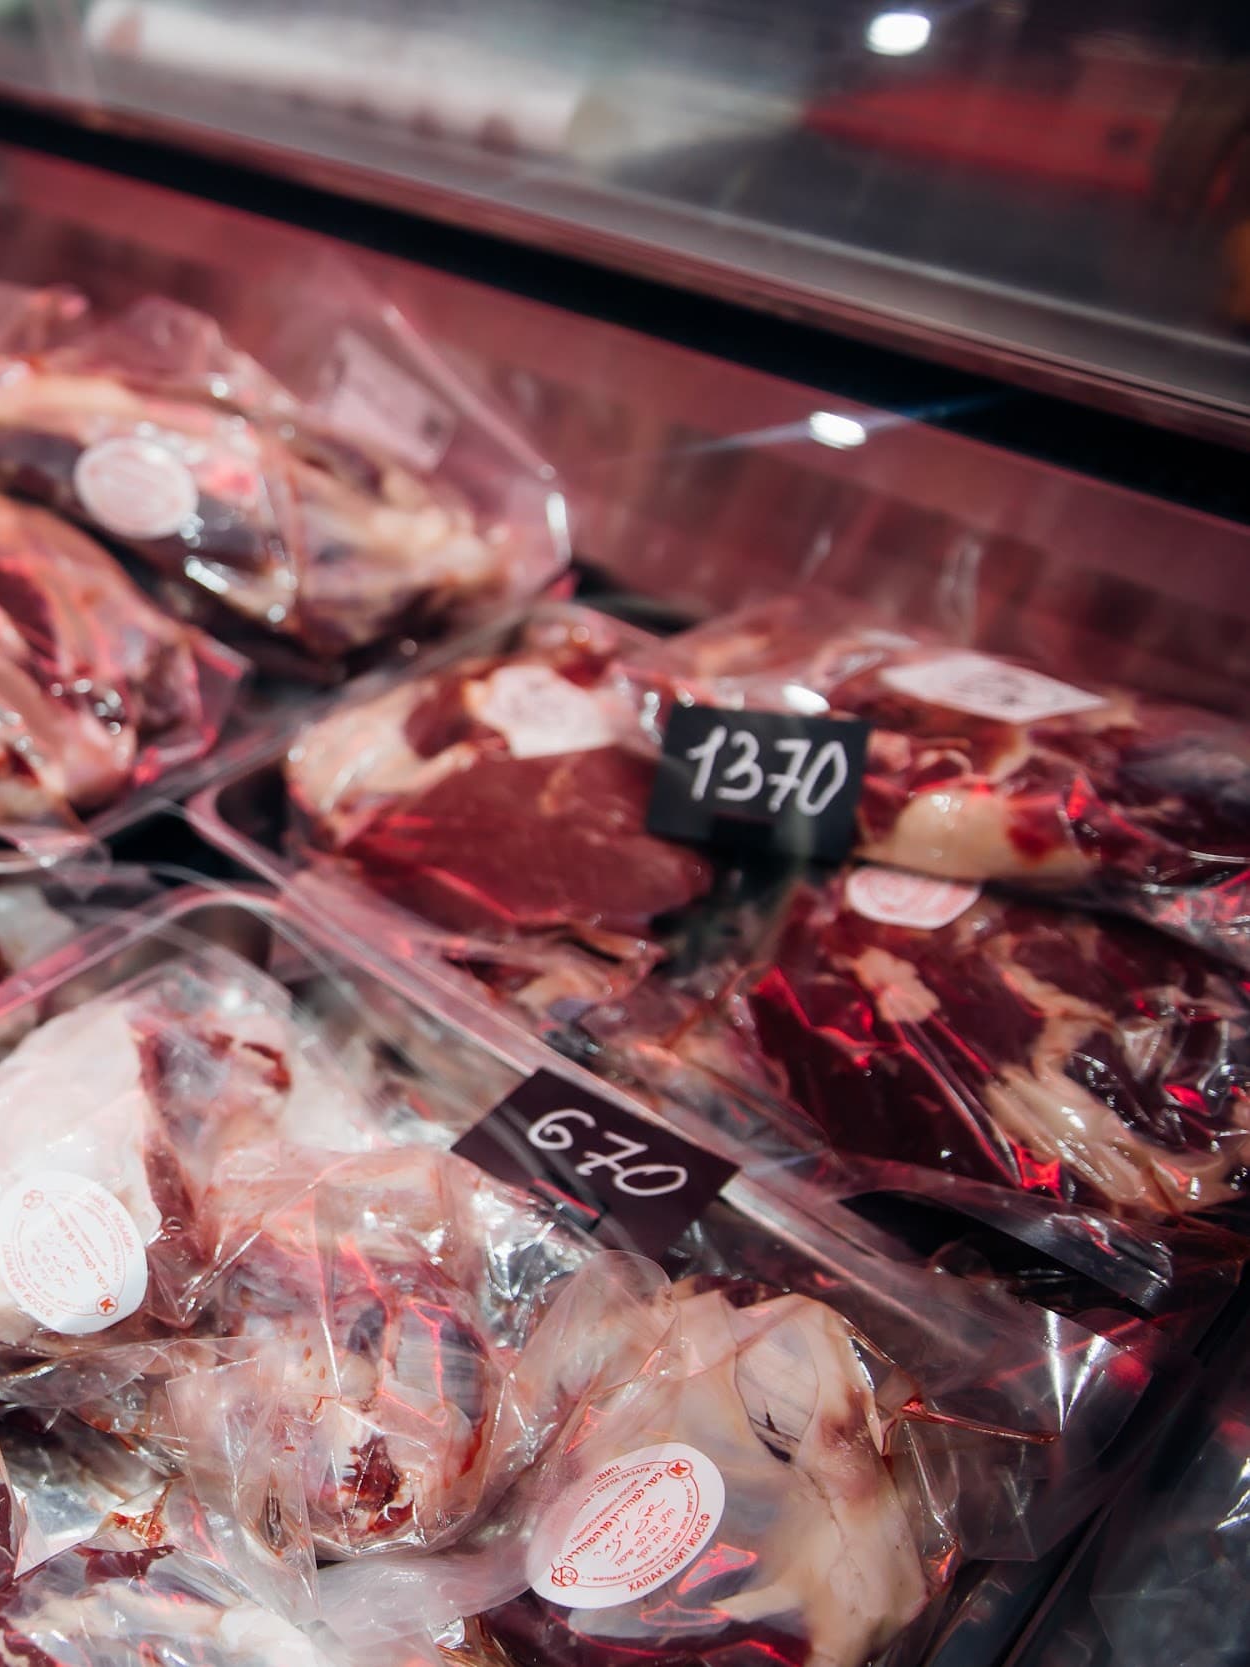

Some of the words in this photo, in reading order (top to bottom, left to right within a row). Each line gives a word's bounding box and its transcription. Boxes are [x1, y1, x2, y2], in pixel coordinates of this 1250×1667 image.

[685, 725, 849, 817] 1370
[526, 1108, 688, 1196] 670
[628, 1568, 666, 1592] ХАЛАК
[686, 1513, 711, 1548] ЙОСЕФ
